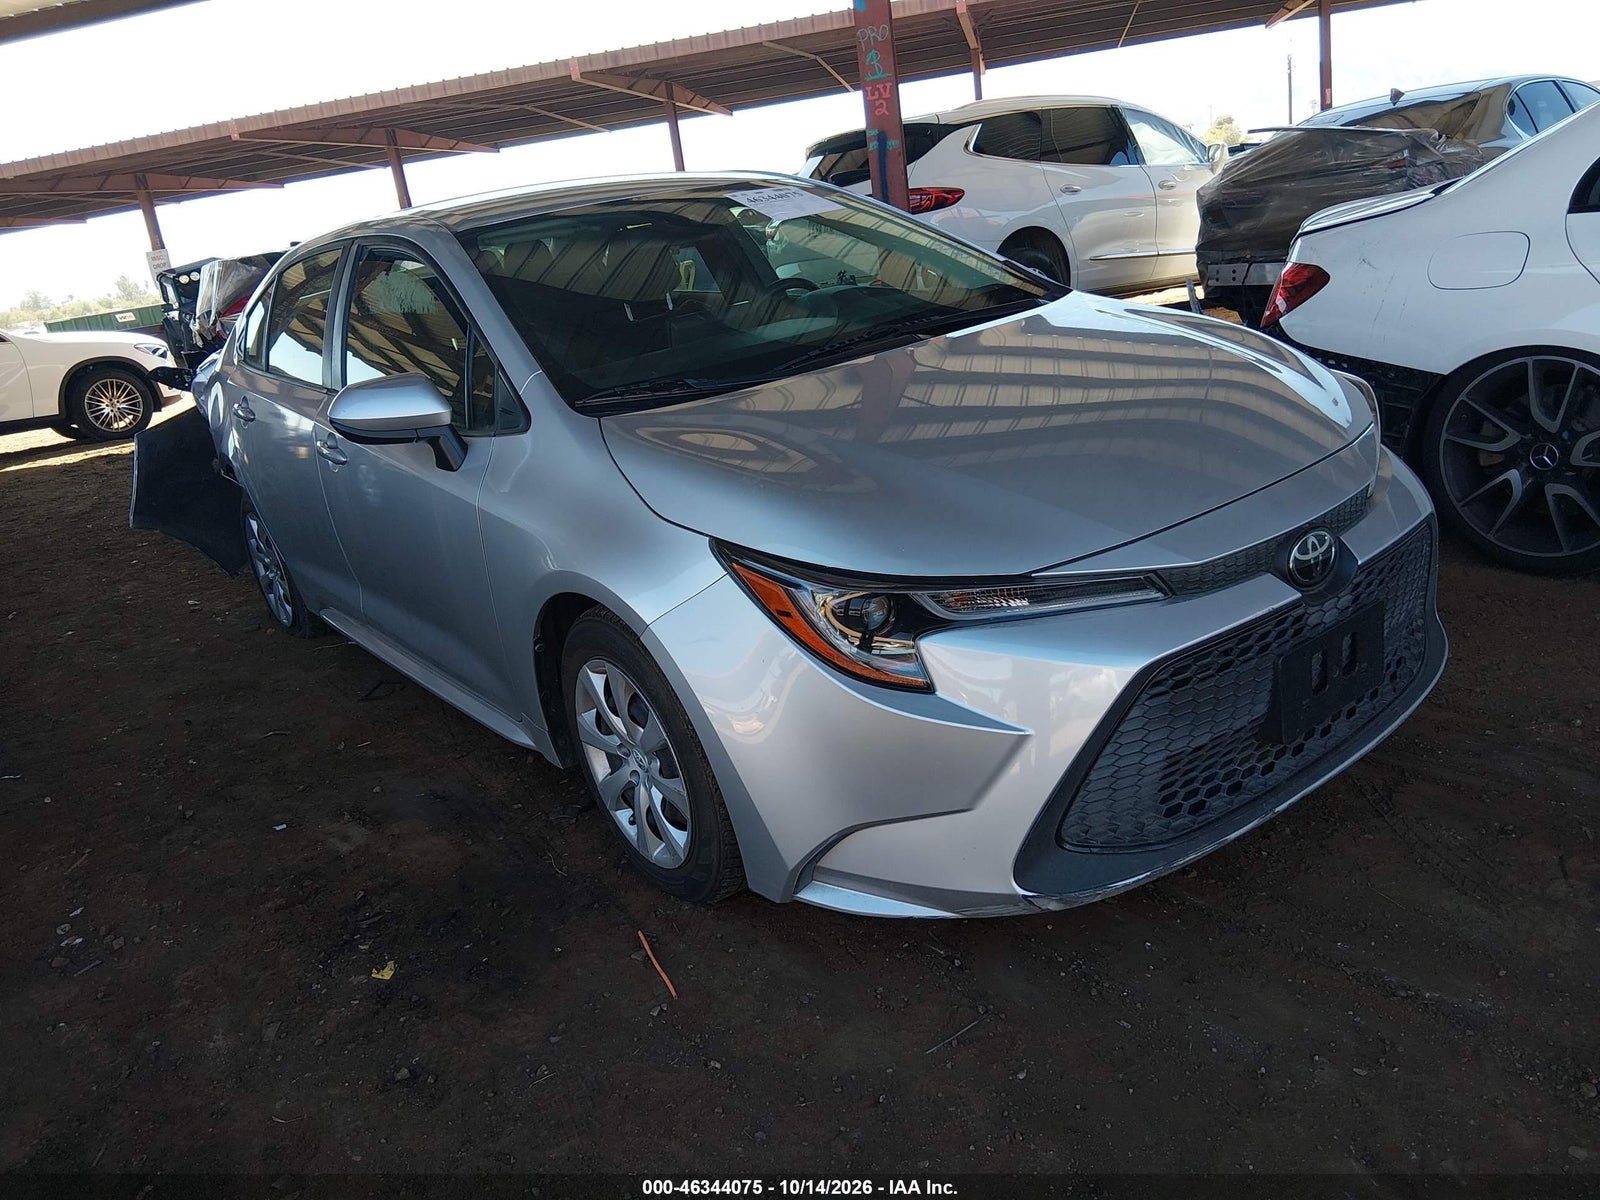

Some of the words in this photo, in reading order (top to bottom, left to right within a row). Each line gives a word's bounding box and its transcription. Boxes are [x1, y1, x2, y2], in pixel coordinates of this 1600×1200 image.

[857, 24, 889, 52] PRO
[865, 82, 893, 100] LV
[875, 99, 889, 116] 2
